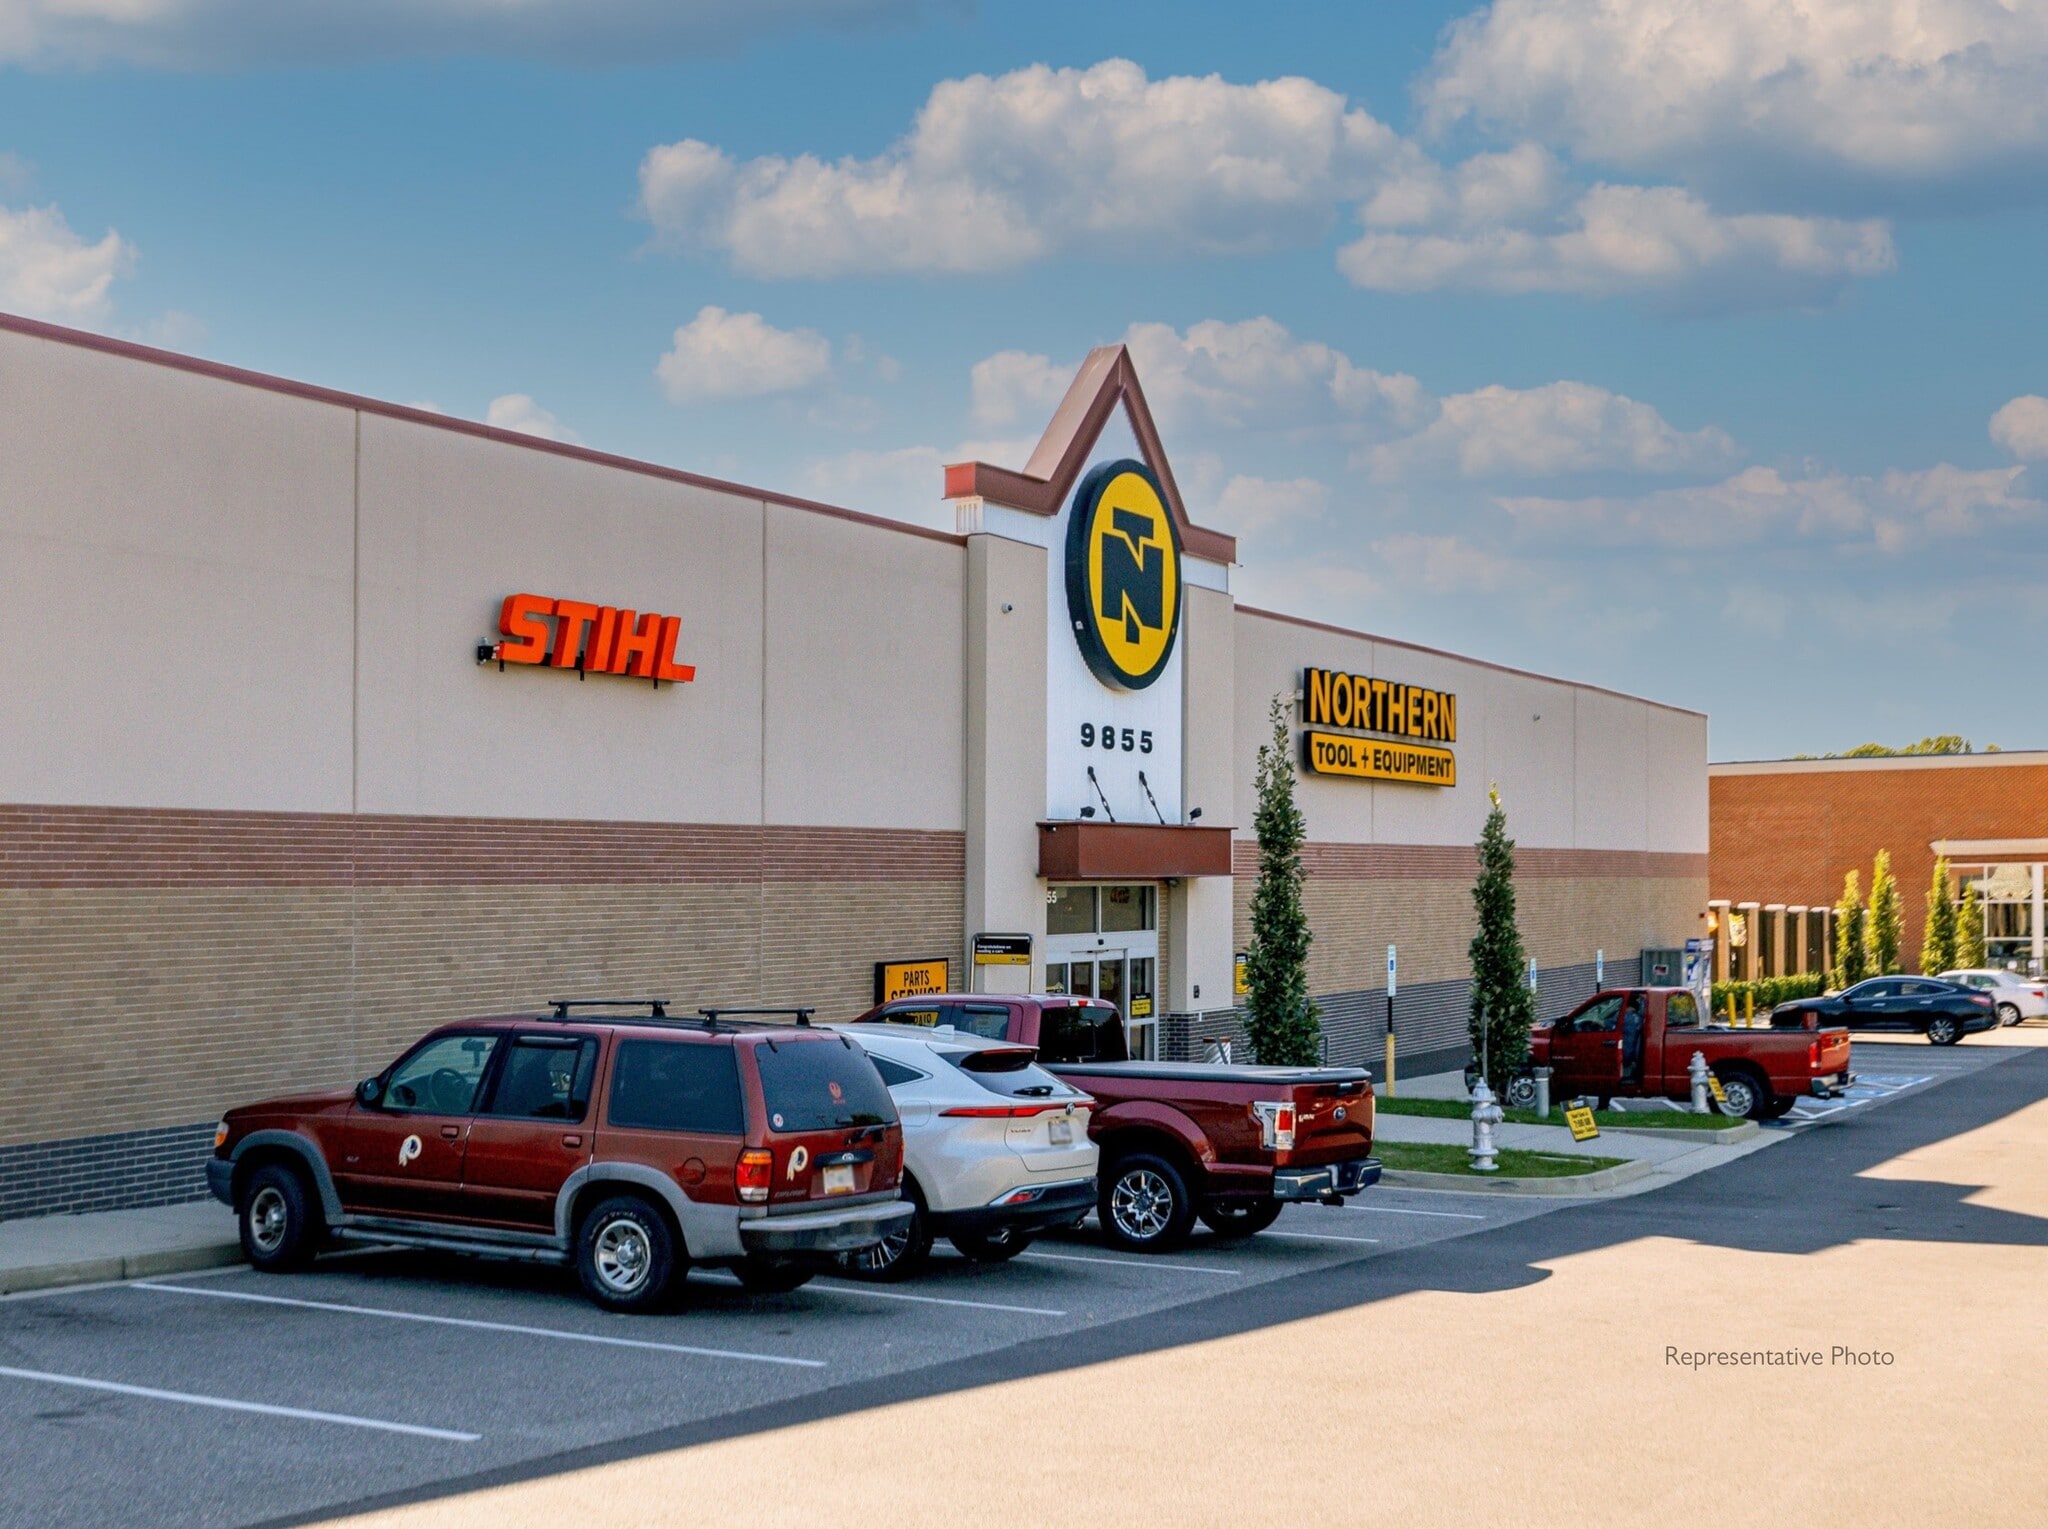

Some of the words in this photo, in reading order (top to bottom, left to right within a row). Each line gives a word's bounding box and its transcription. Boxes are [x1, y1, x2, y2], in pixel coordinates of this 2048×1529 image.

[498, 592, 697, 682] STIHL
[1305, 668, 1456, 743] NORTHERN
[1080, 722, 1154, 754] 9855
[1316, 741, 1357, 768] TOOL
[1373, 748, 1452, 779] EQUIPMENT
[903, 969, 930, 987] PARTS
